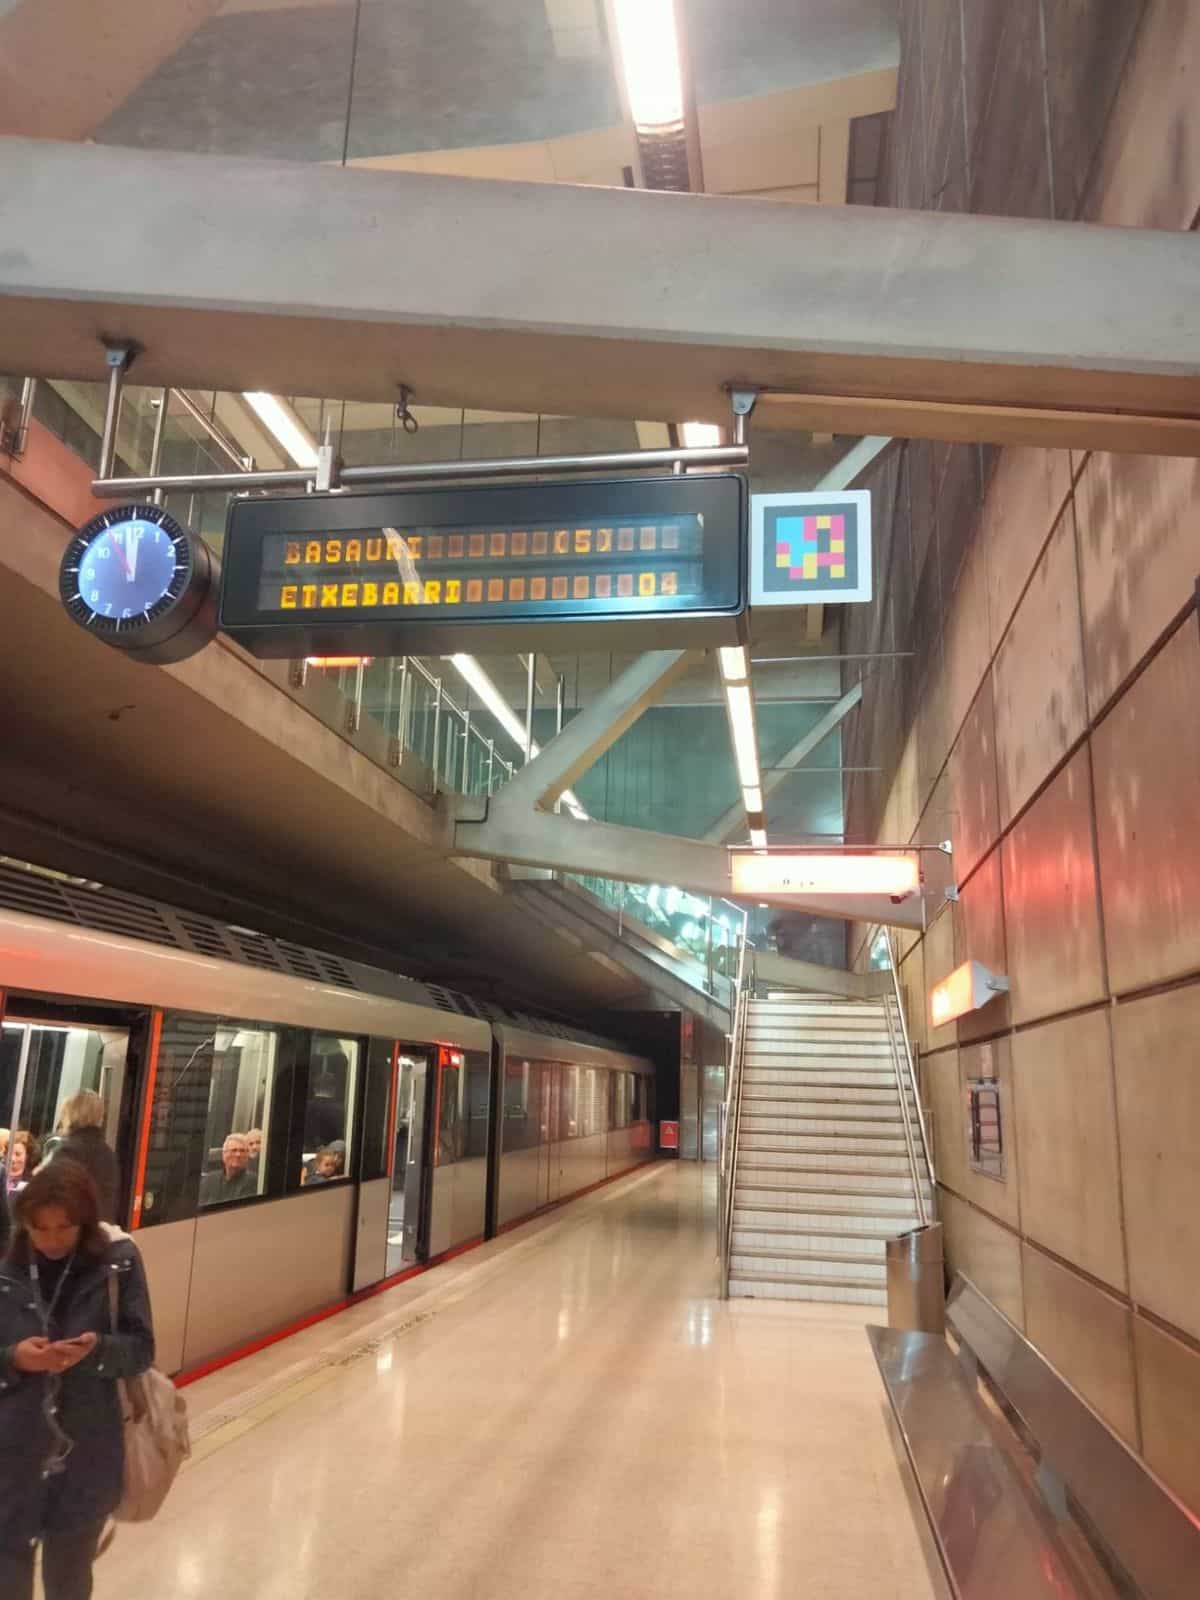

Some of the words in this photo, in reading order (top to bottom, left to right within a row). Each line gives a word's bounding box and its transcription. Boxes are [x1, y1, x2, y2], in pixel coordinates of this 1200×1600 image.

[167, 545, 176, 557] 2
[285, 536, 424, 564] BASAURI
[86, 568, 95, 581] 9
[280, 580, 461, 609] ETXEBARRI
[103, 603, 113, 615] 7
